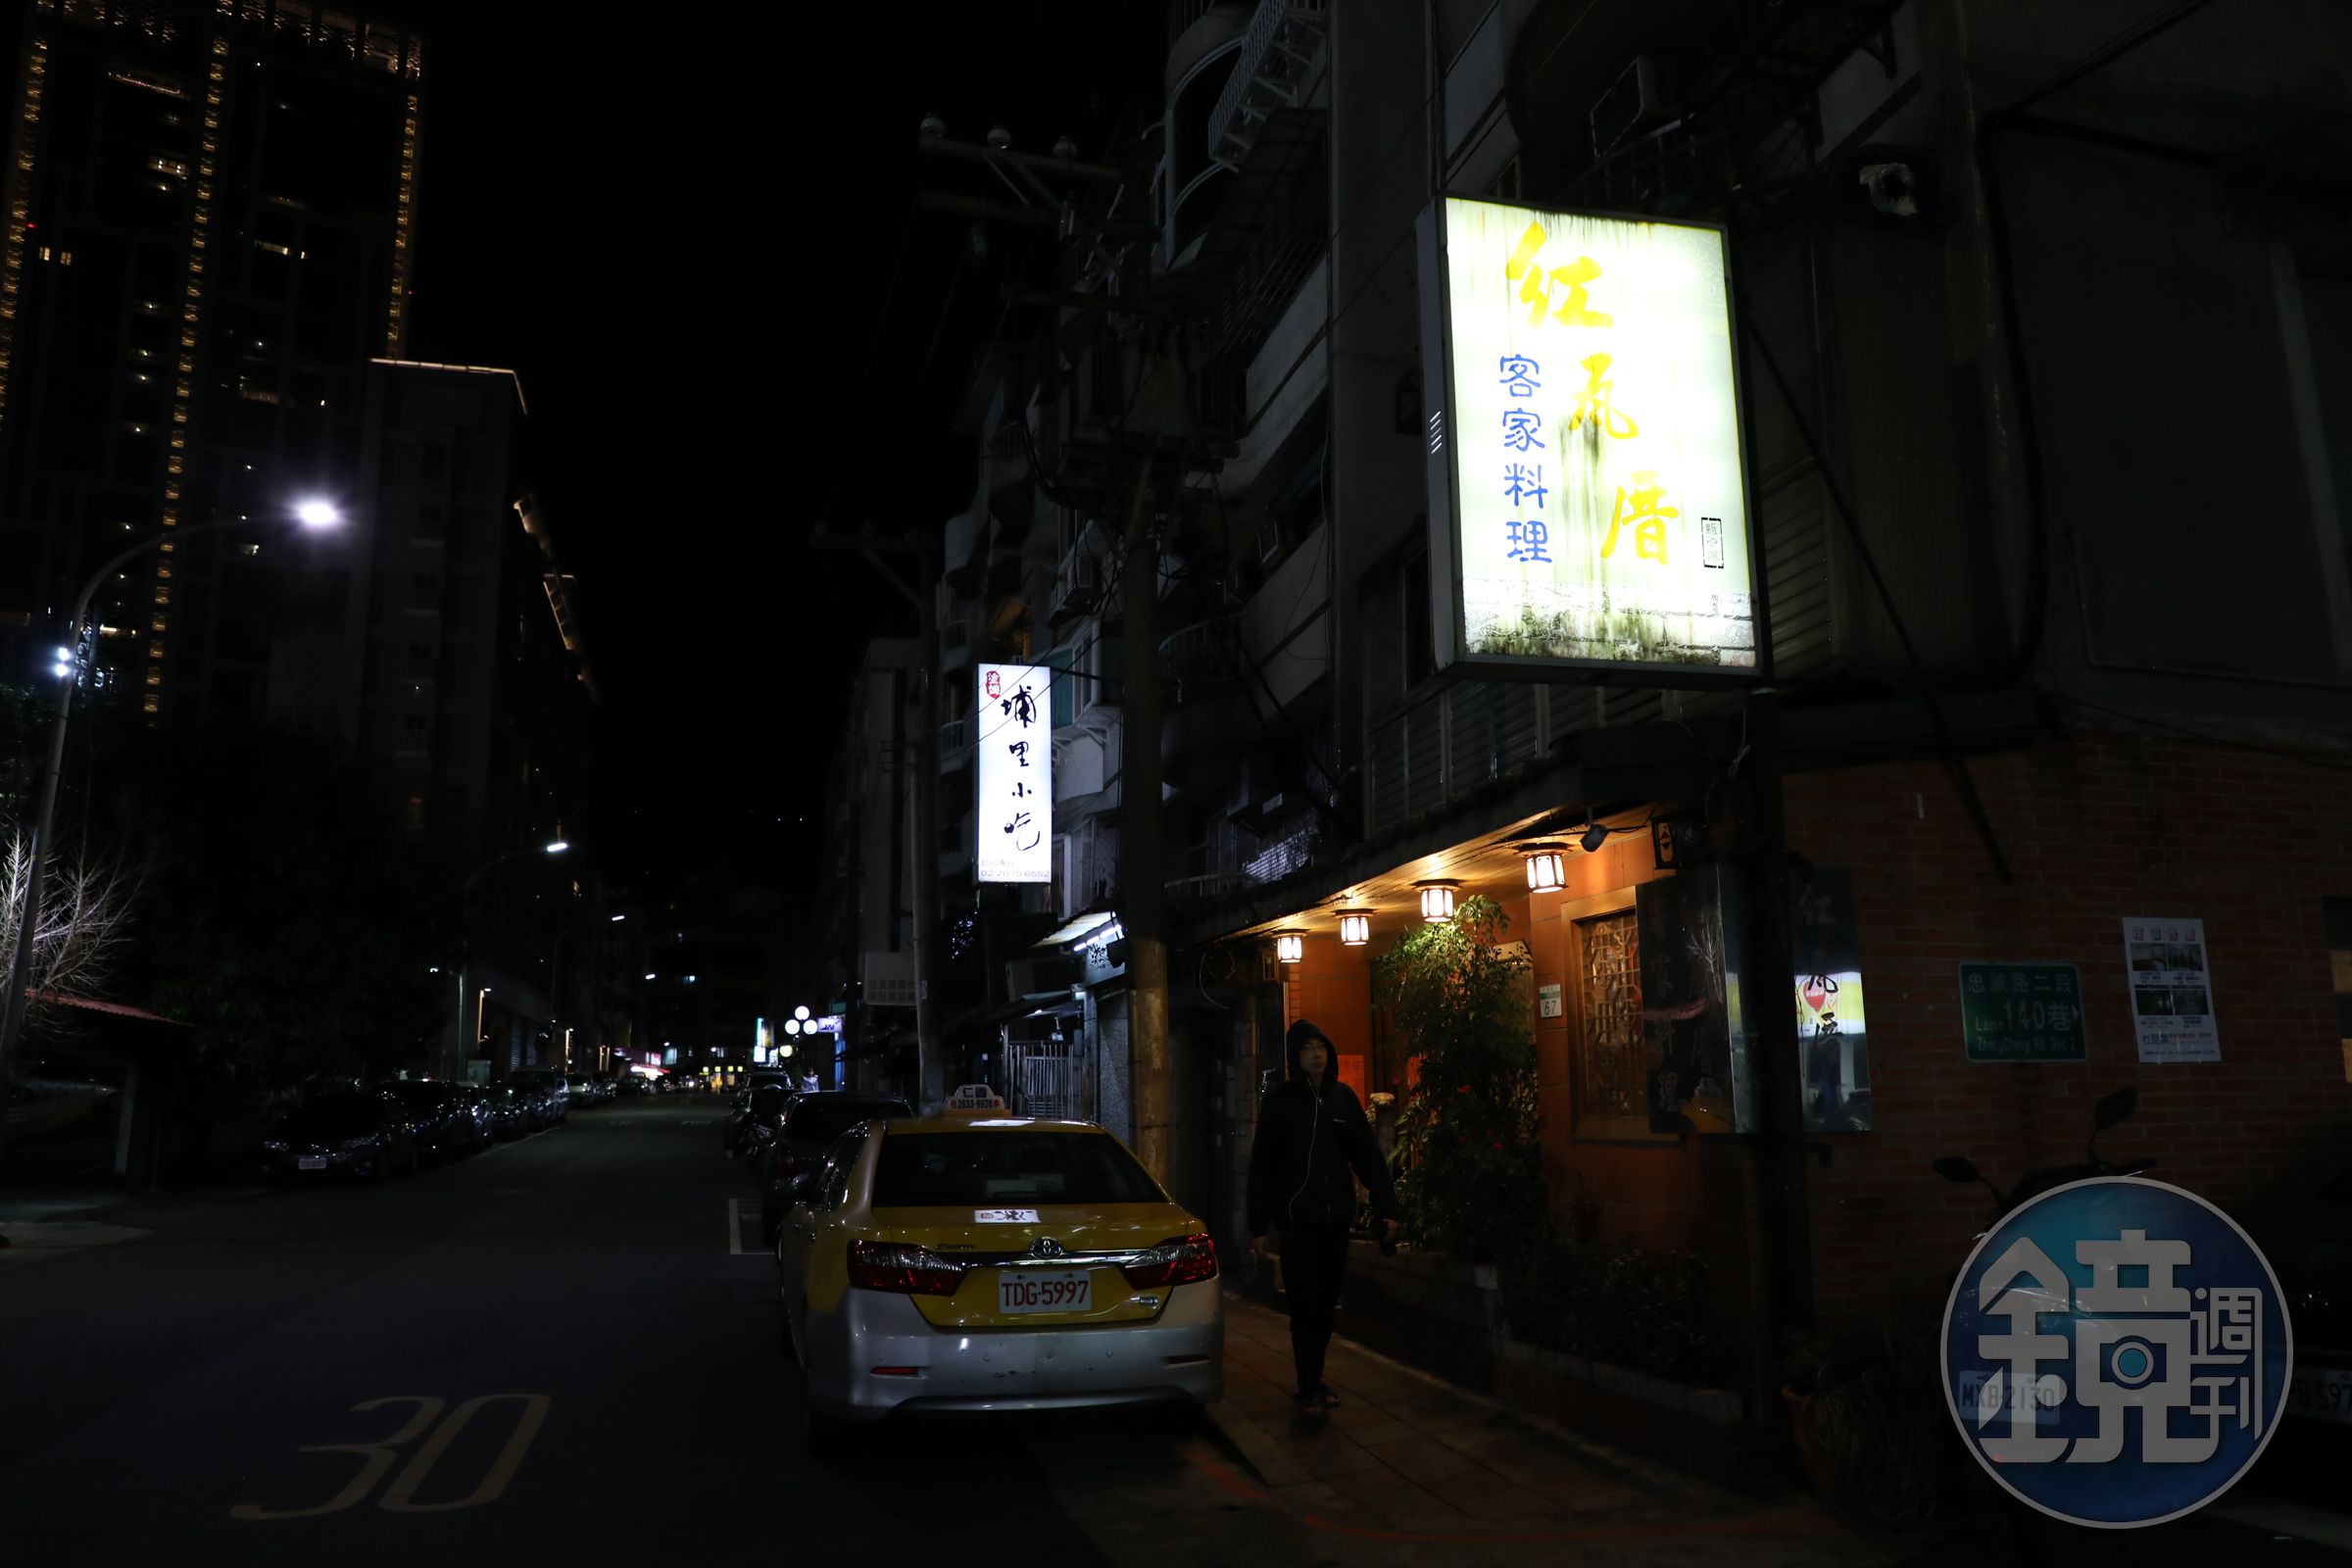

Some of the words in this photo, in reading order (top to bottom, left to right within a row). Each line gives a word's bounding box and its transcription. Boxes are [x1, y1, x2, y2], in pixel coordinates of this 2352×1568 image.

[1498, 354, 1553, 564] 客家料理
[1001, 684, 1041, 851] 埔里小吃
[1544, 1000, 1556, 1015] 67
[1968, 971, 2073, 993] 忠誠路二段
[1975, 1015, 2004, 1032] Lane
[2003, 1000, 2072, 1032] 140巷
[228, 1393, 553, 1521] 30
